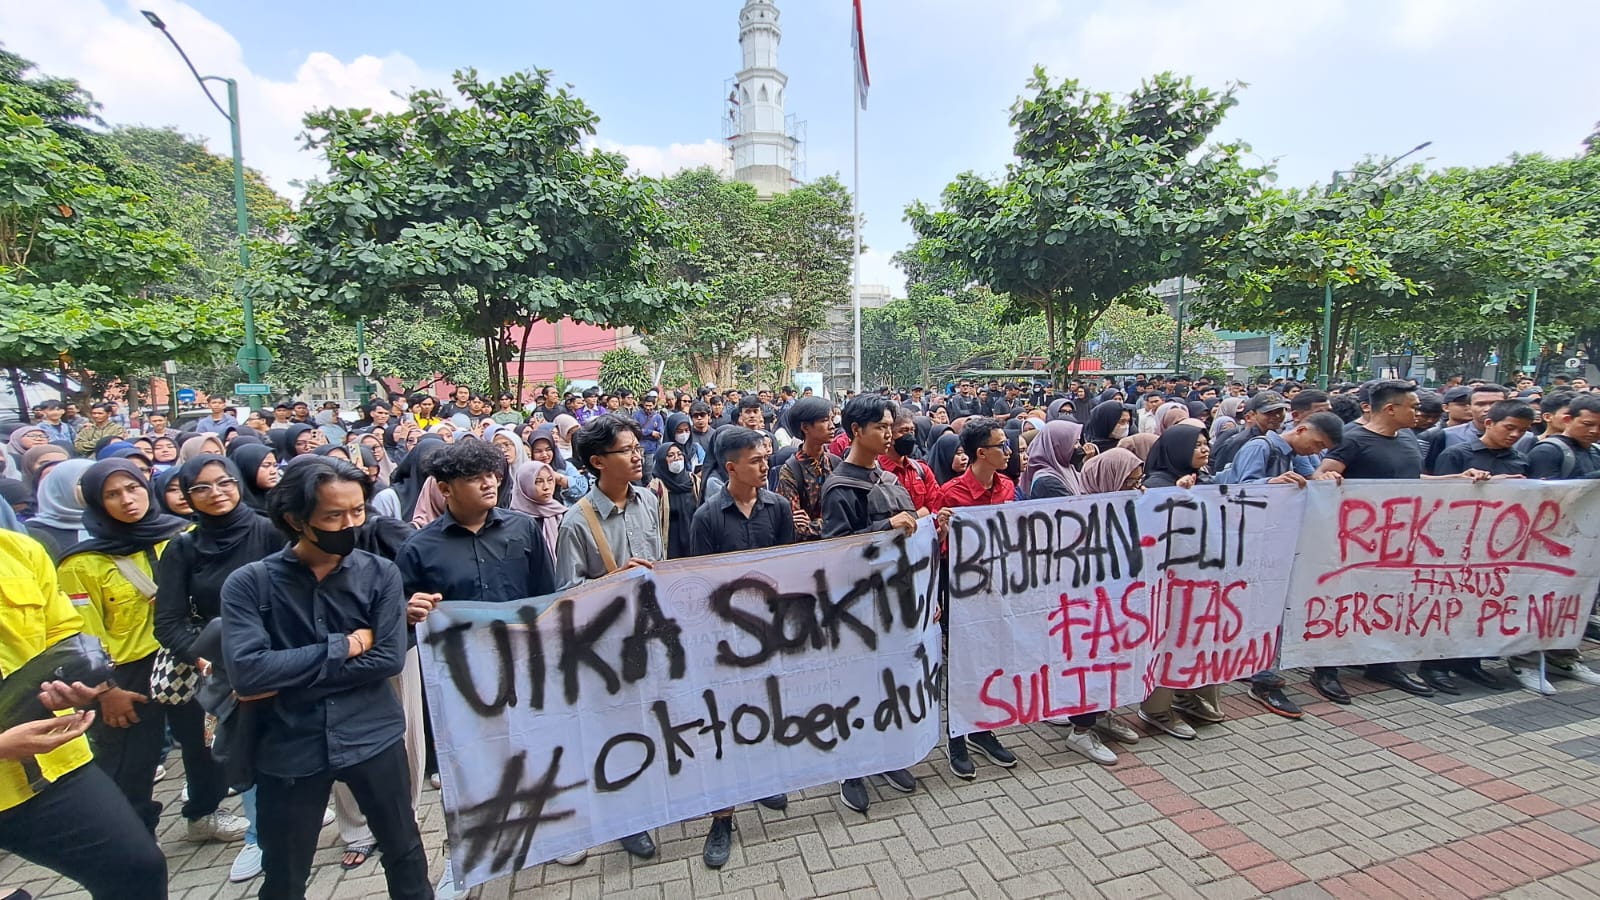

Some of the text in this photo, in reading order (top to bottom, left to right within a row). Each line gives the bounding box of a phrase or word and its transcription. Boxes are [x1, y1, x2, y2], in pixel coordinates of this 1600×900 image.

[363, 357, 369, 372] P
[950, 498, 1143, 599] BAYARAN
[1337, 496, 1572, 565] REKTOR
[1303, 592, 1463, 641] BERSIKAP
[1411, 567, 1510, 598] HARUS
[423, 579, 686, 718] UIKA
[975, 662, 1132, 730] SULIT
